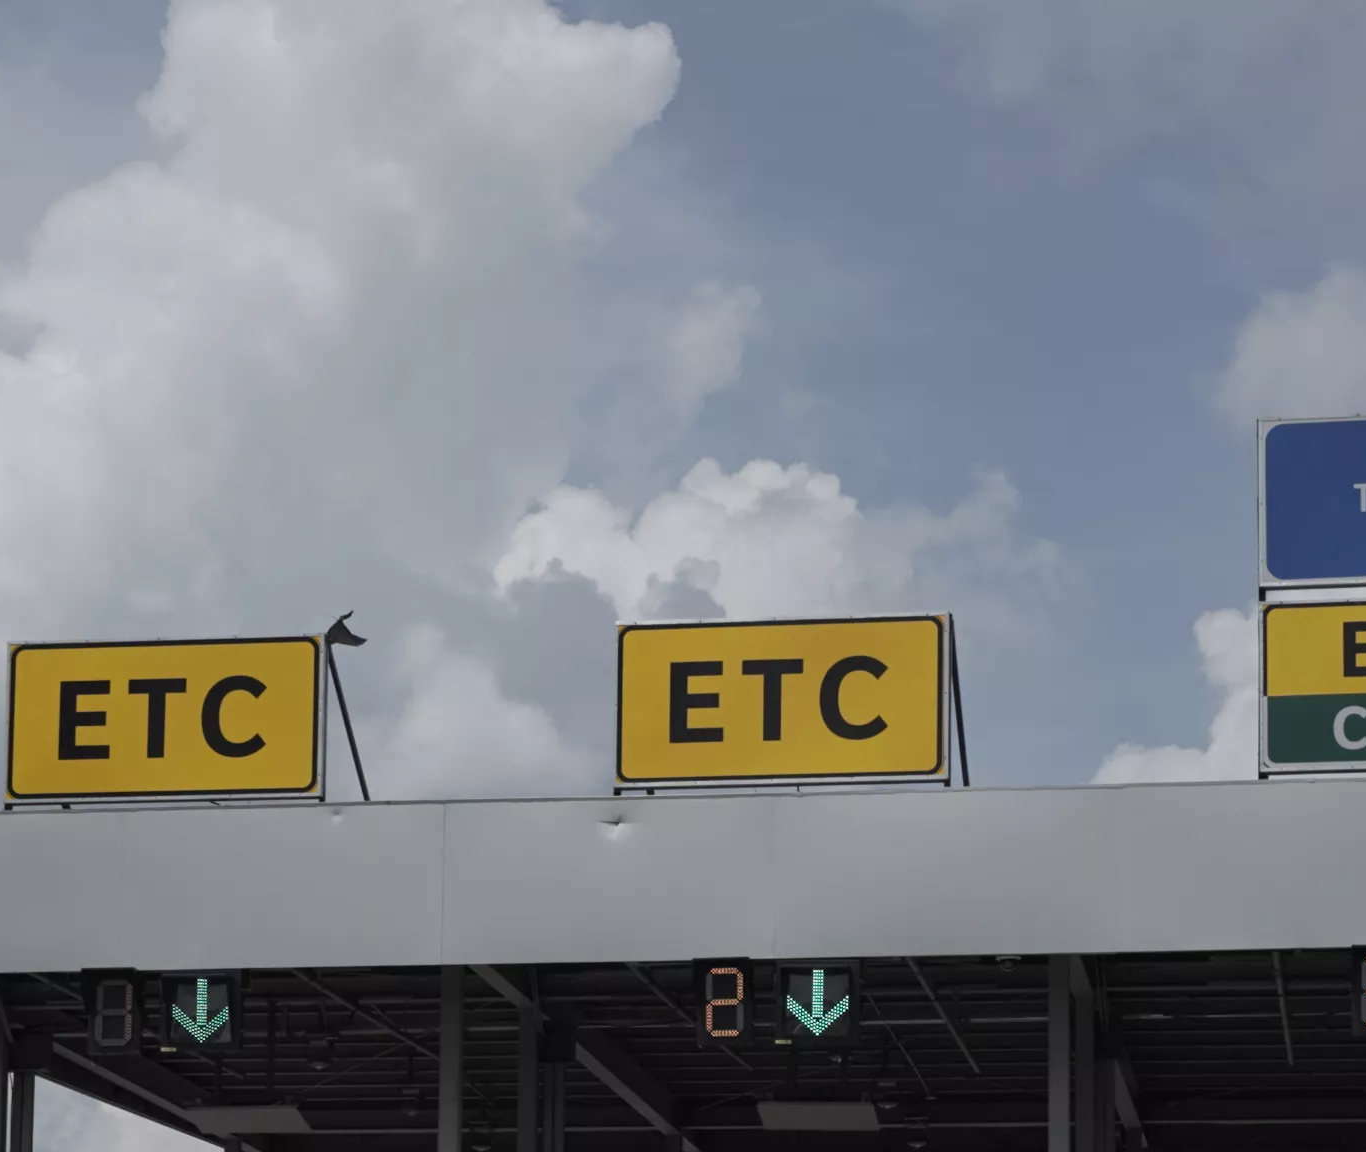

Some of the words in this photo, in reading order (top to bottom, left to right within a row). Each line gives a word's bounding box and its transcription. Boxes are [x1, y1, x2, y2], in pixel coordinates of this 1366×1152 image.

[57, 674, 268, 761] ETC
[667, 654, 889, 745] ETC
[705, 967, 744, 1037] 2
